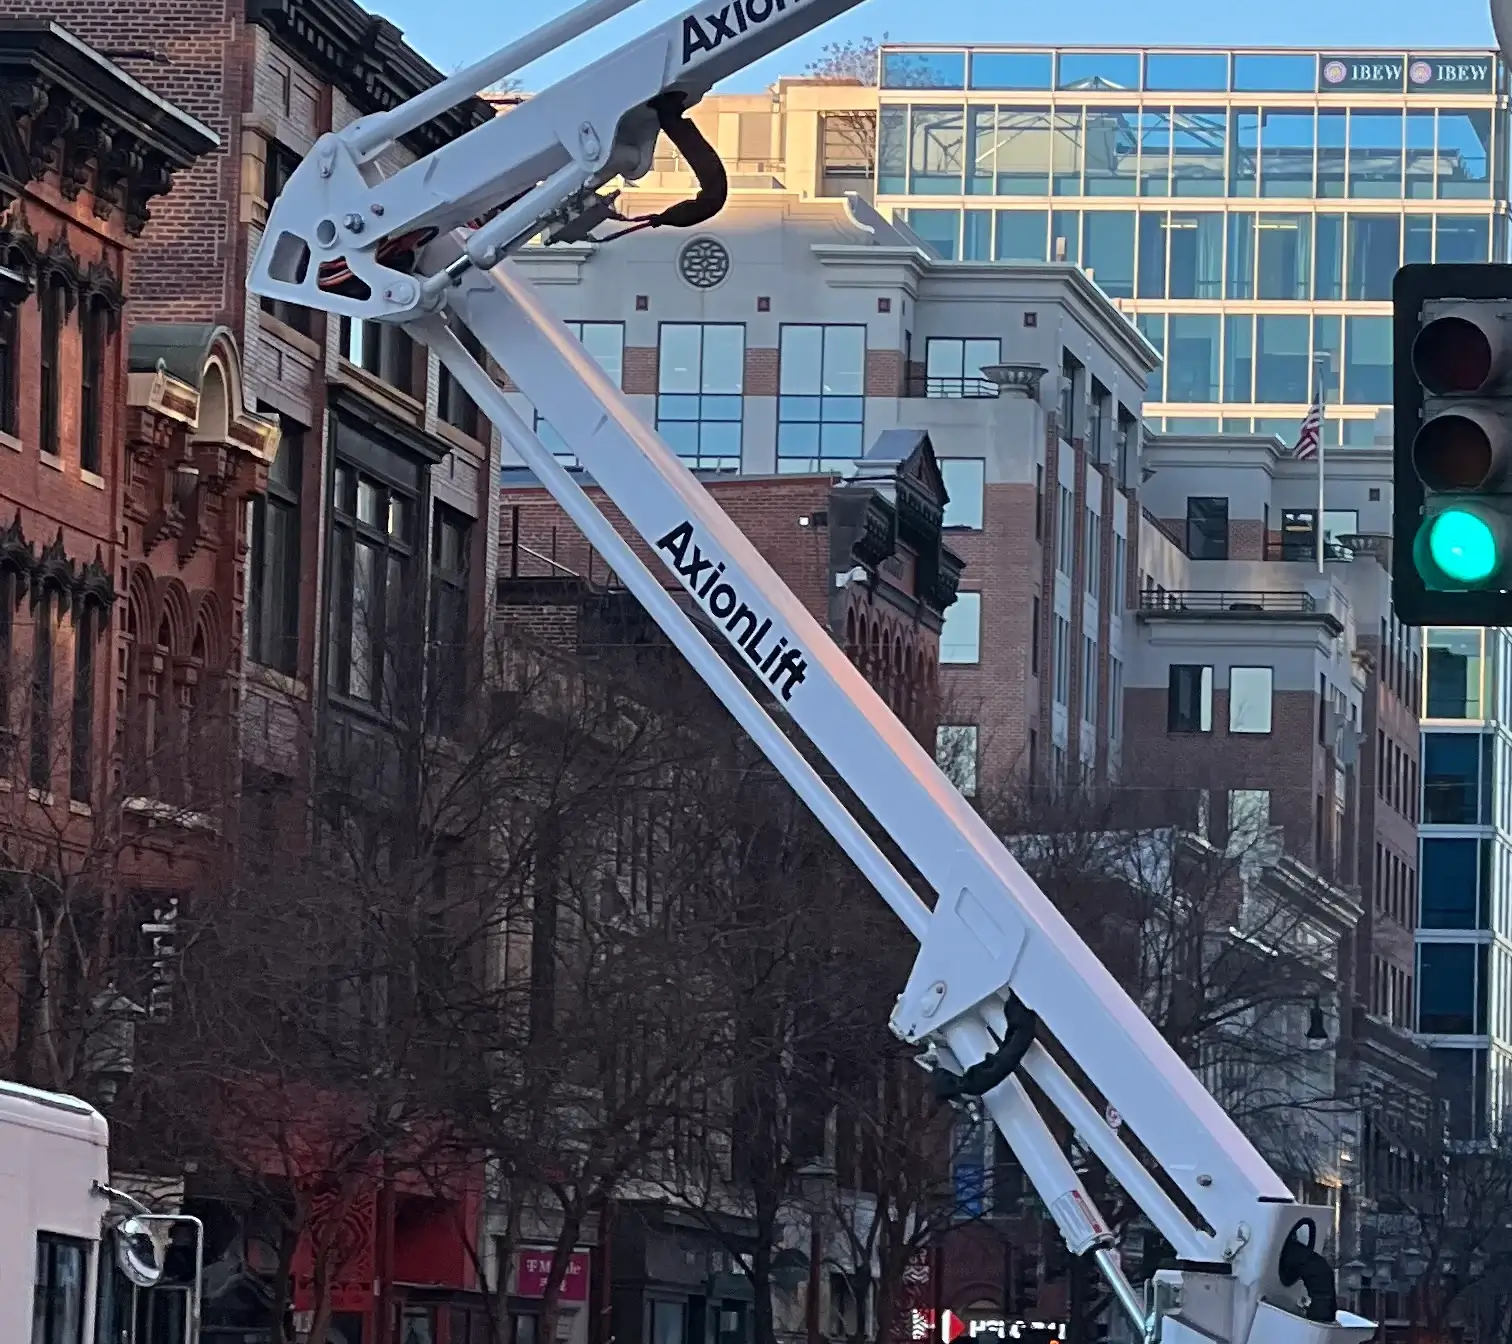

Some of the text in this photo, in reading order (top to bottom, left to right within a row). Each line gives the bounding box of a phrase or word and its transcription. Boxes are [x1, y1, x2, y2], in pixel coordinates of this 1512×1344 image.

[1351, 64, 1402, 81] IBEW
[1436, 64, 1488, 81] IBEW
[655, 520, 808, 702] AxionLift
